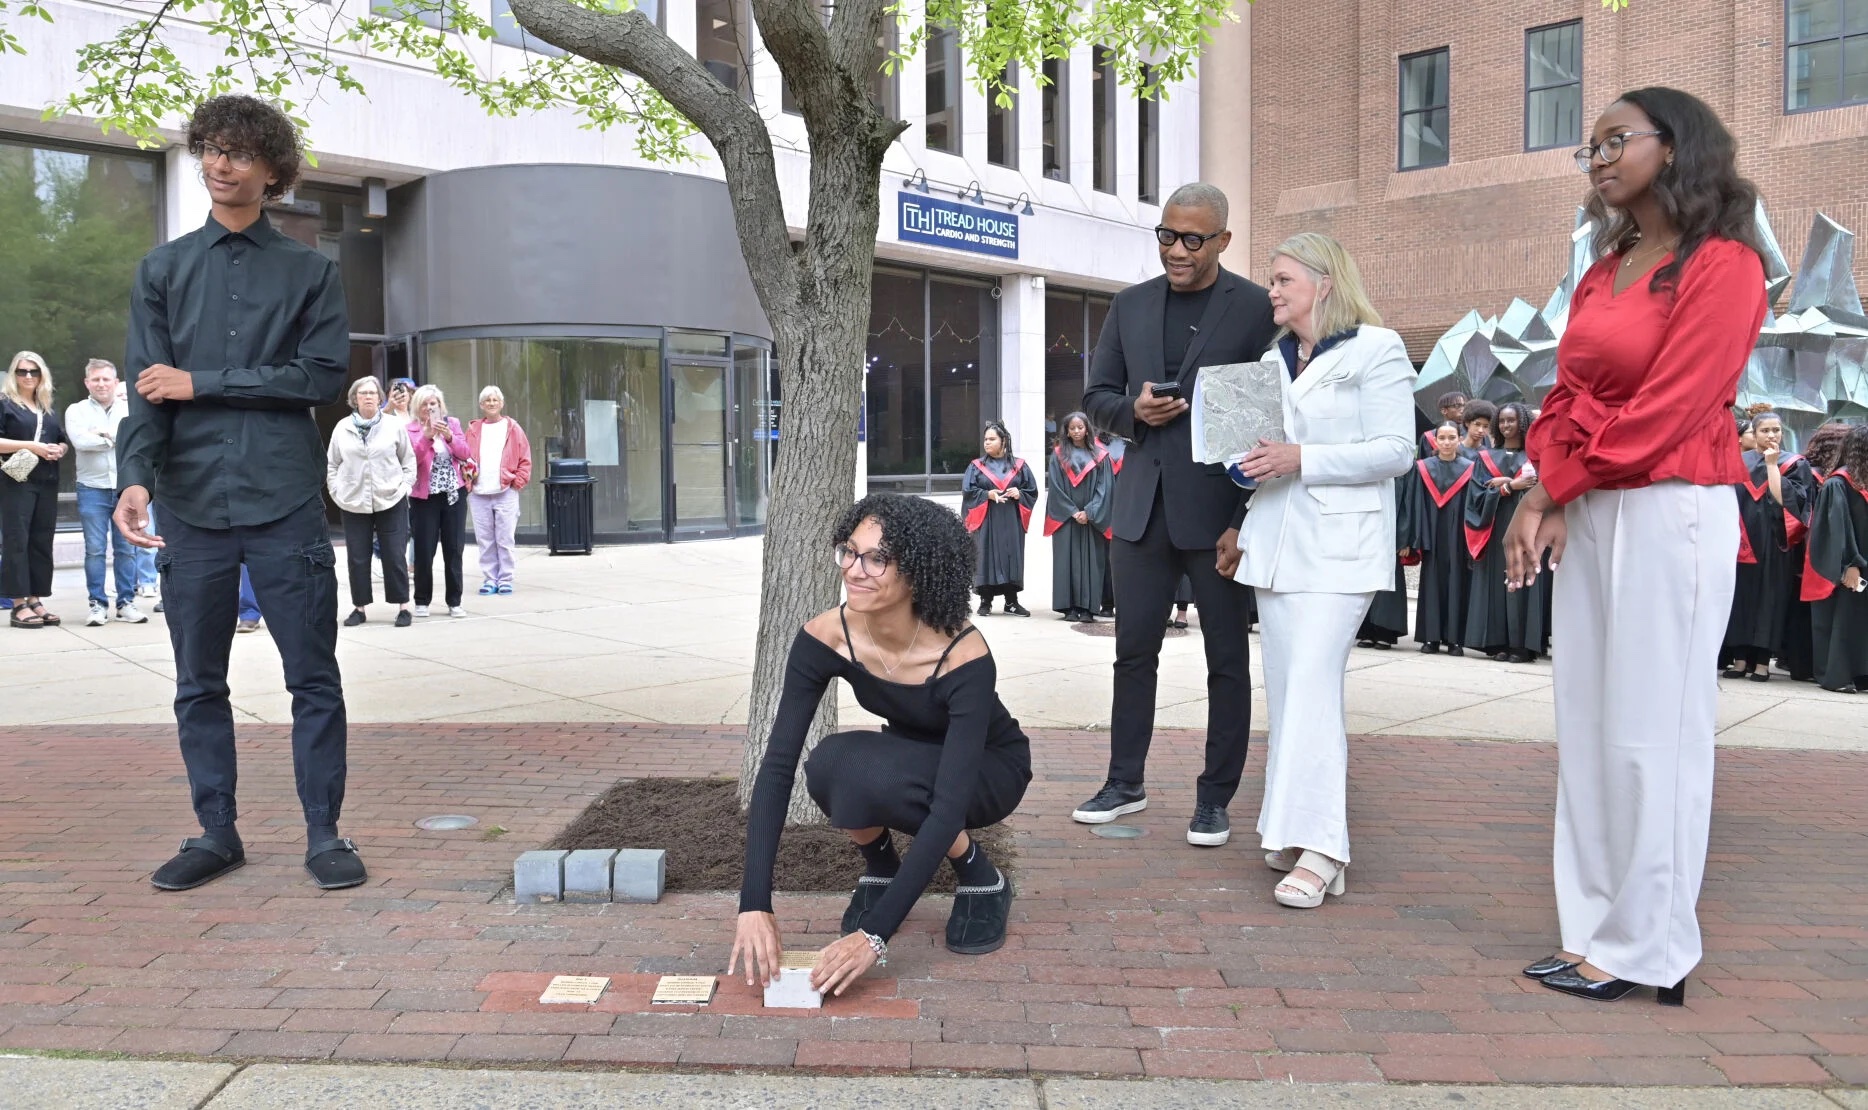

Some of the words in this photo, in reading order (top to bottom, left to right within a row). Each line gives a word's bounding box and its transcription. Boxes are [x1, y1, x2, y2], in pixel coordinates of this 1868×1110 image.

[906, 207, 930, 230] TH
[936, 209, 974, 229] TREAD
[977, 217, 1016, 238] HOUSE
[936, 228, 963, 240] CARDIO
[964, 235, 980, 243] AND
[981, 237, 1016, 249] STRENGTH
